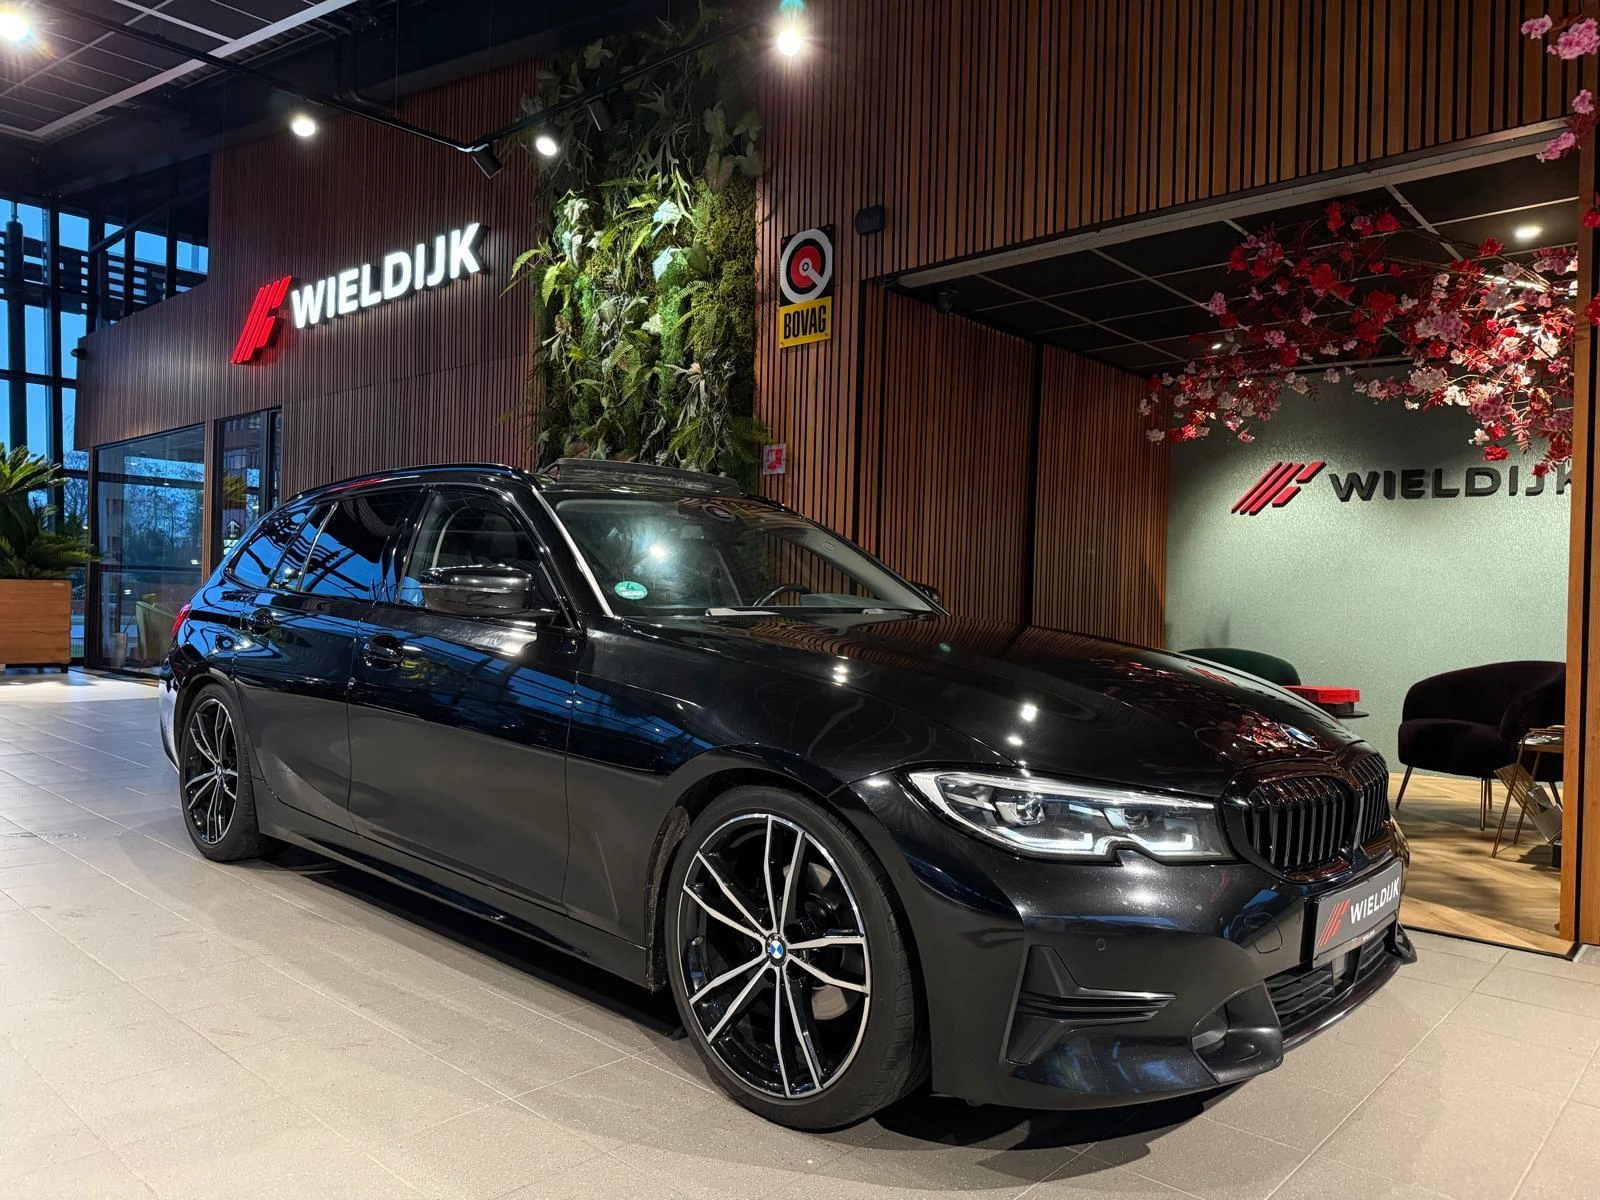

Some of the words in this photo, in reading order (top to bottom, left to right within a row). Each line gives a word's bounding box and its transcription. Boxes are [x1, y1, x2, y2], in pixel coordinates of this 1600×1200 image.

[291, 222, 480, 329] WIELDIJK
[784, 304, 827, 339] BOVAG
[1350, 876, 1399, 925] WIELDIJK
